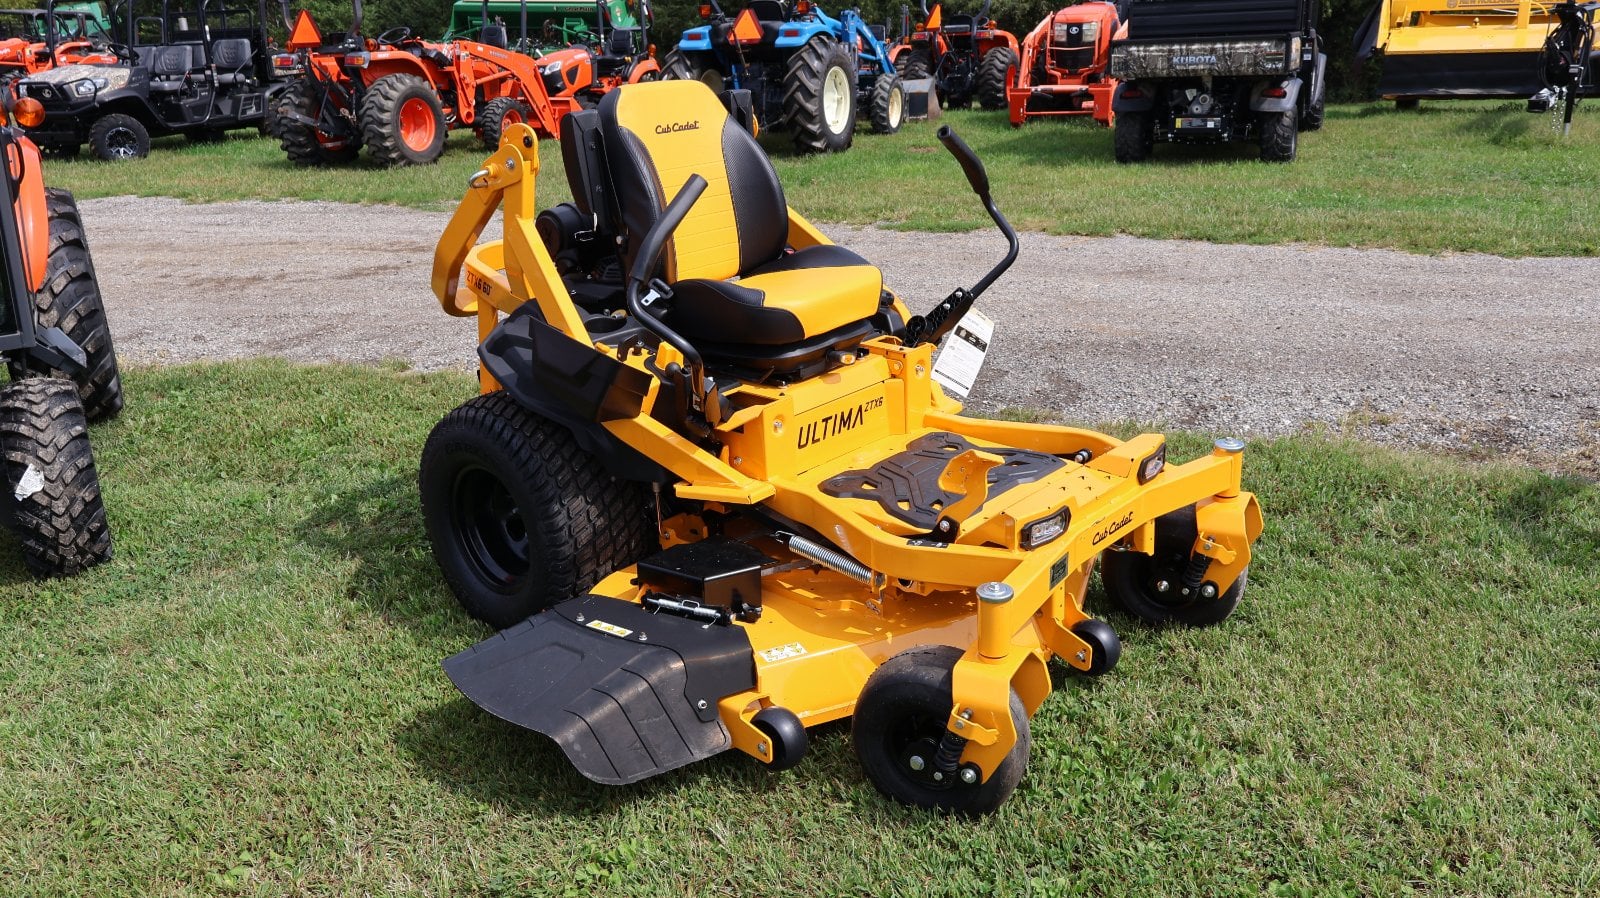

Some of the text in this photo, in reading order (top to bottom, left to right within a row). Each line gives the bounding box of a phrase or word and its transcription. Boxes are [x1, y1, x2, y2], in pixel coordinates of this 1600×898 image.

[1172, 55, 1217, 65] KUBOTA
[655, 120, 699, 134] Cub Cadet
[864, 396, 884, 413] ZTX6
[1092, 511, 1133, 545] Cub Cadet
